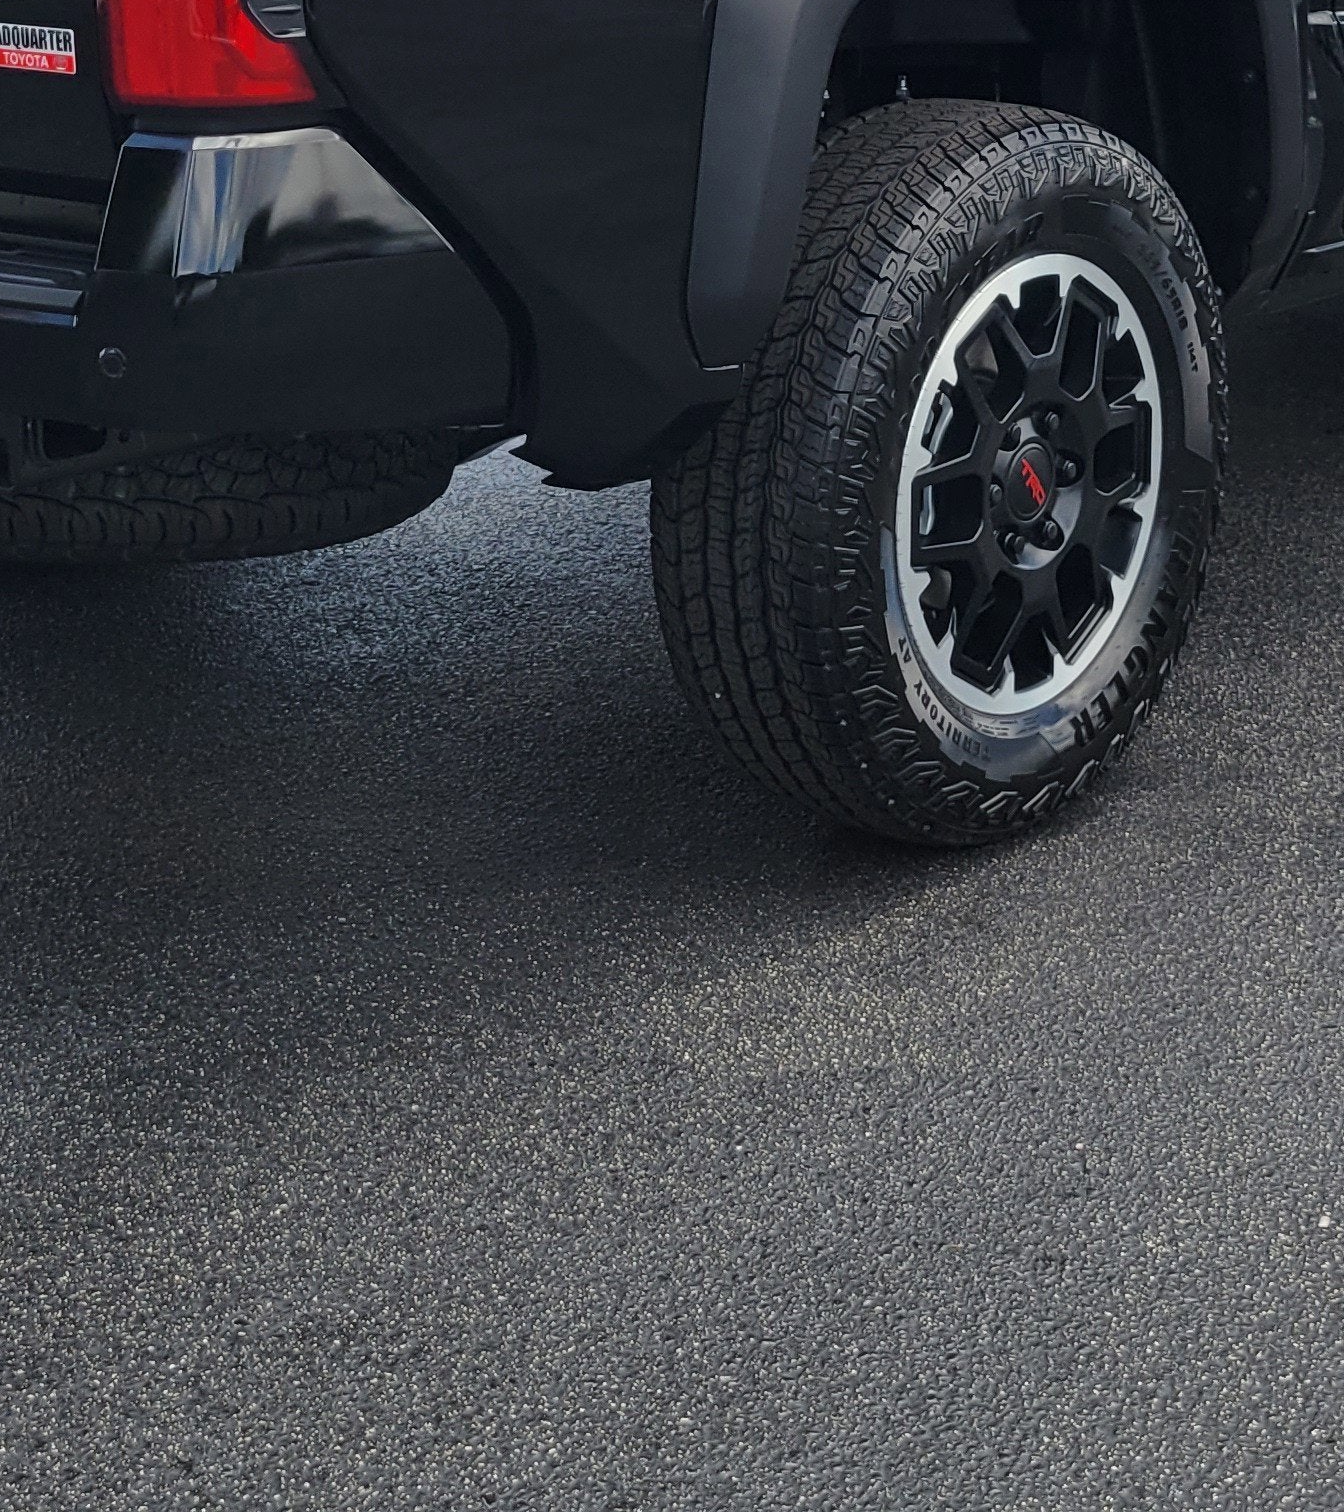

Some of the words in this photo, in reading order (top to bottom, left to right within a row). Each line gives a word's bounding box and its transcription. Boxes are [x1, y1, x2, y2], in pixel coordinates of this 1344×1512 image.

[2, 50, 50, 69] TOYOTA
[1020, 458, 1046, 506] TRD
[913, 679, 992, 762] TERRITORY
